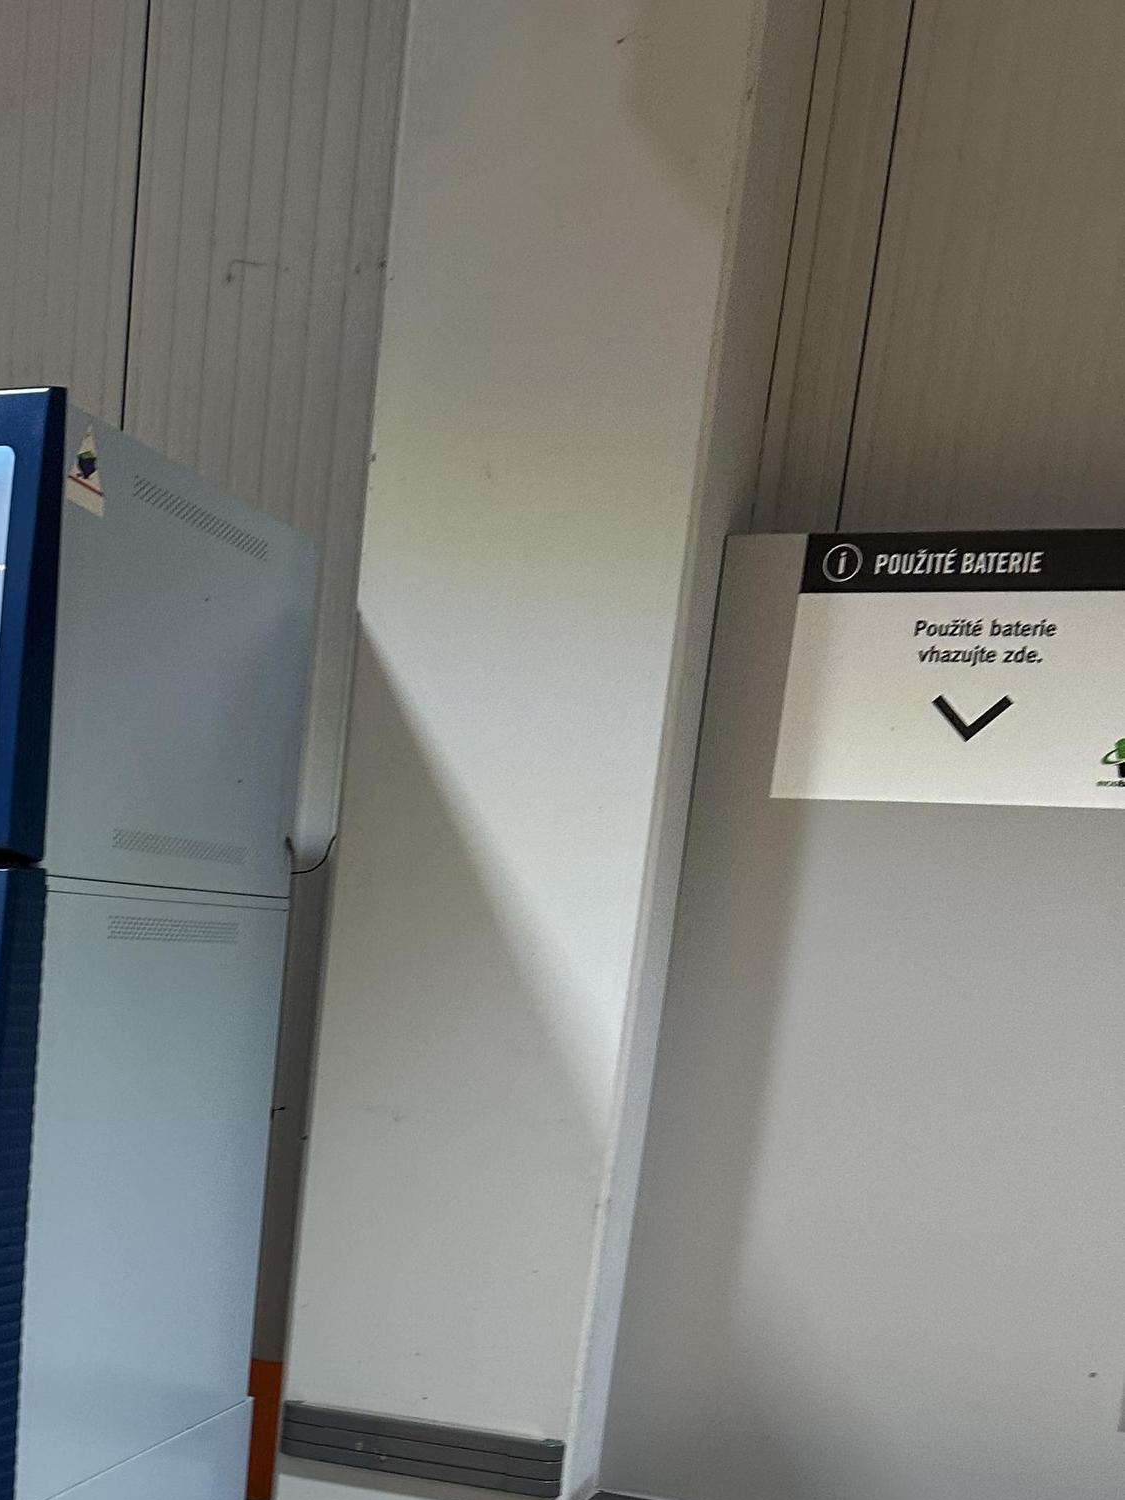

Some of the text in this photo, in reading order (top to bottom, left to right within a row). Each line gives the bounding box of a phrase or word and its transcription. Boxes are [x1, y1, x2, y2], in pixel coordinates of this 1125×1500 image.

[873, 547, 957, 575] POUŽITÉ
[960, 551, 1043, 574] BATERIE
[913, 617, 1057, 638] Použité baterie
[918, 645, 1044, 667] vhazujte zde.
